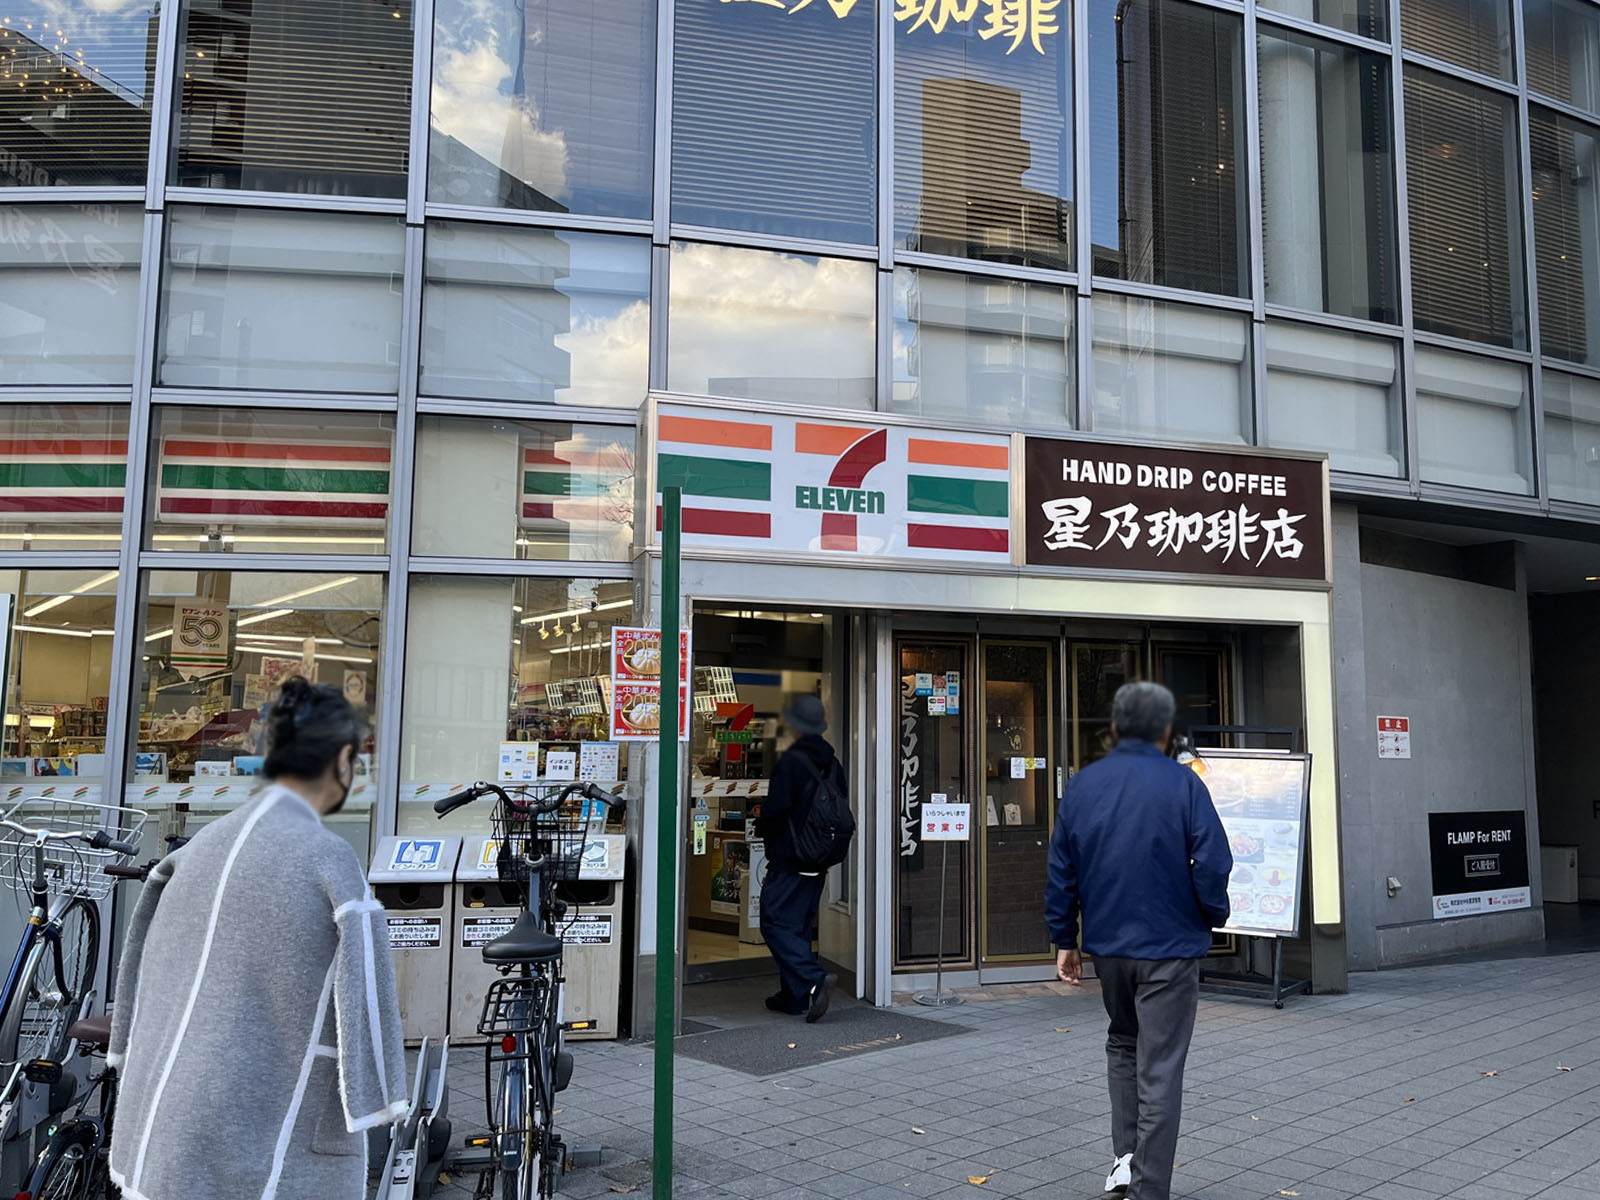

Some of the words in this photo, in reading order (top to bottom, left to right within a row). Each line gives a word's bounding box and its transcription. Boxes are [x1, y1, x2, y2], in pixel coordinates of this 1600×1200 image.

[1062, 458, 1132, 486] HAND
[1137, 464, 1193, 490] DRIP
[1201, 470, 1288, 497] COFFEE
[1040, 495, 1308, 568] 星乃珈琲店
[180, 615, 224, 647] 50
[926, 823, 965, 832] 営業中
[1447, 831, 1475, 845] FLAMP
[1477, 831, 1490, 843] For
[1491, 830, 1511, 842] RENT
